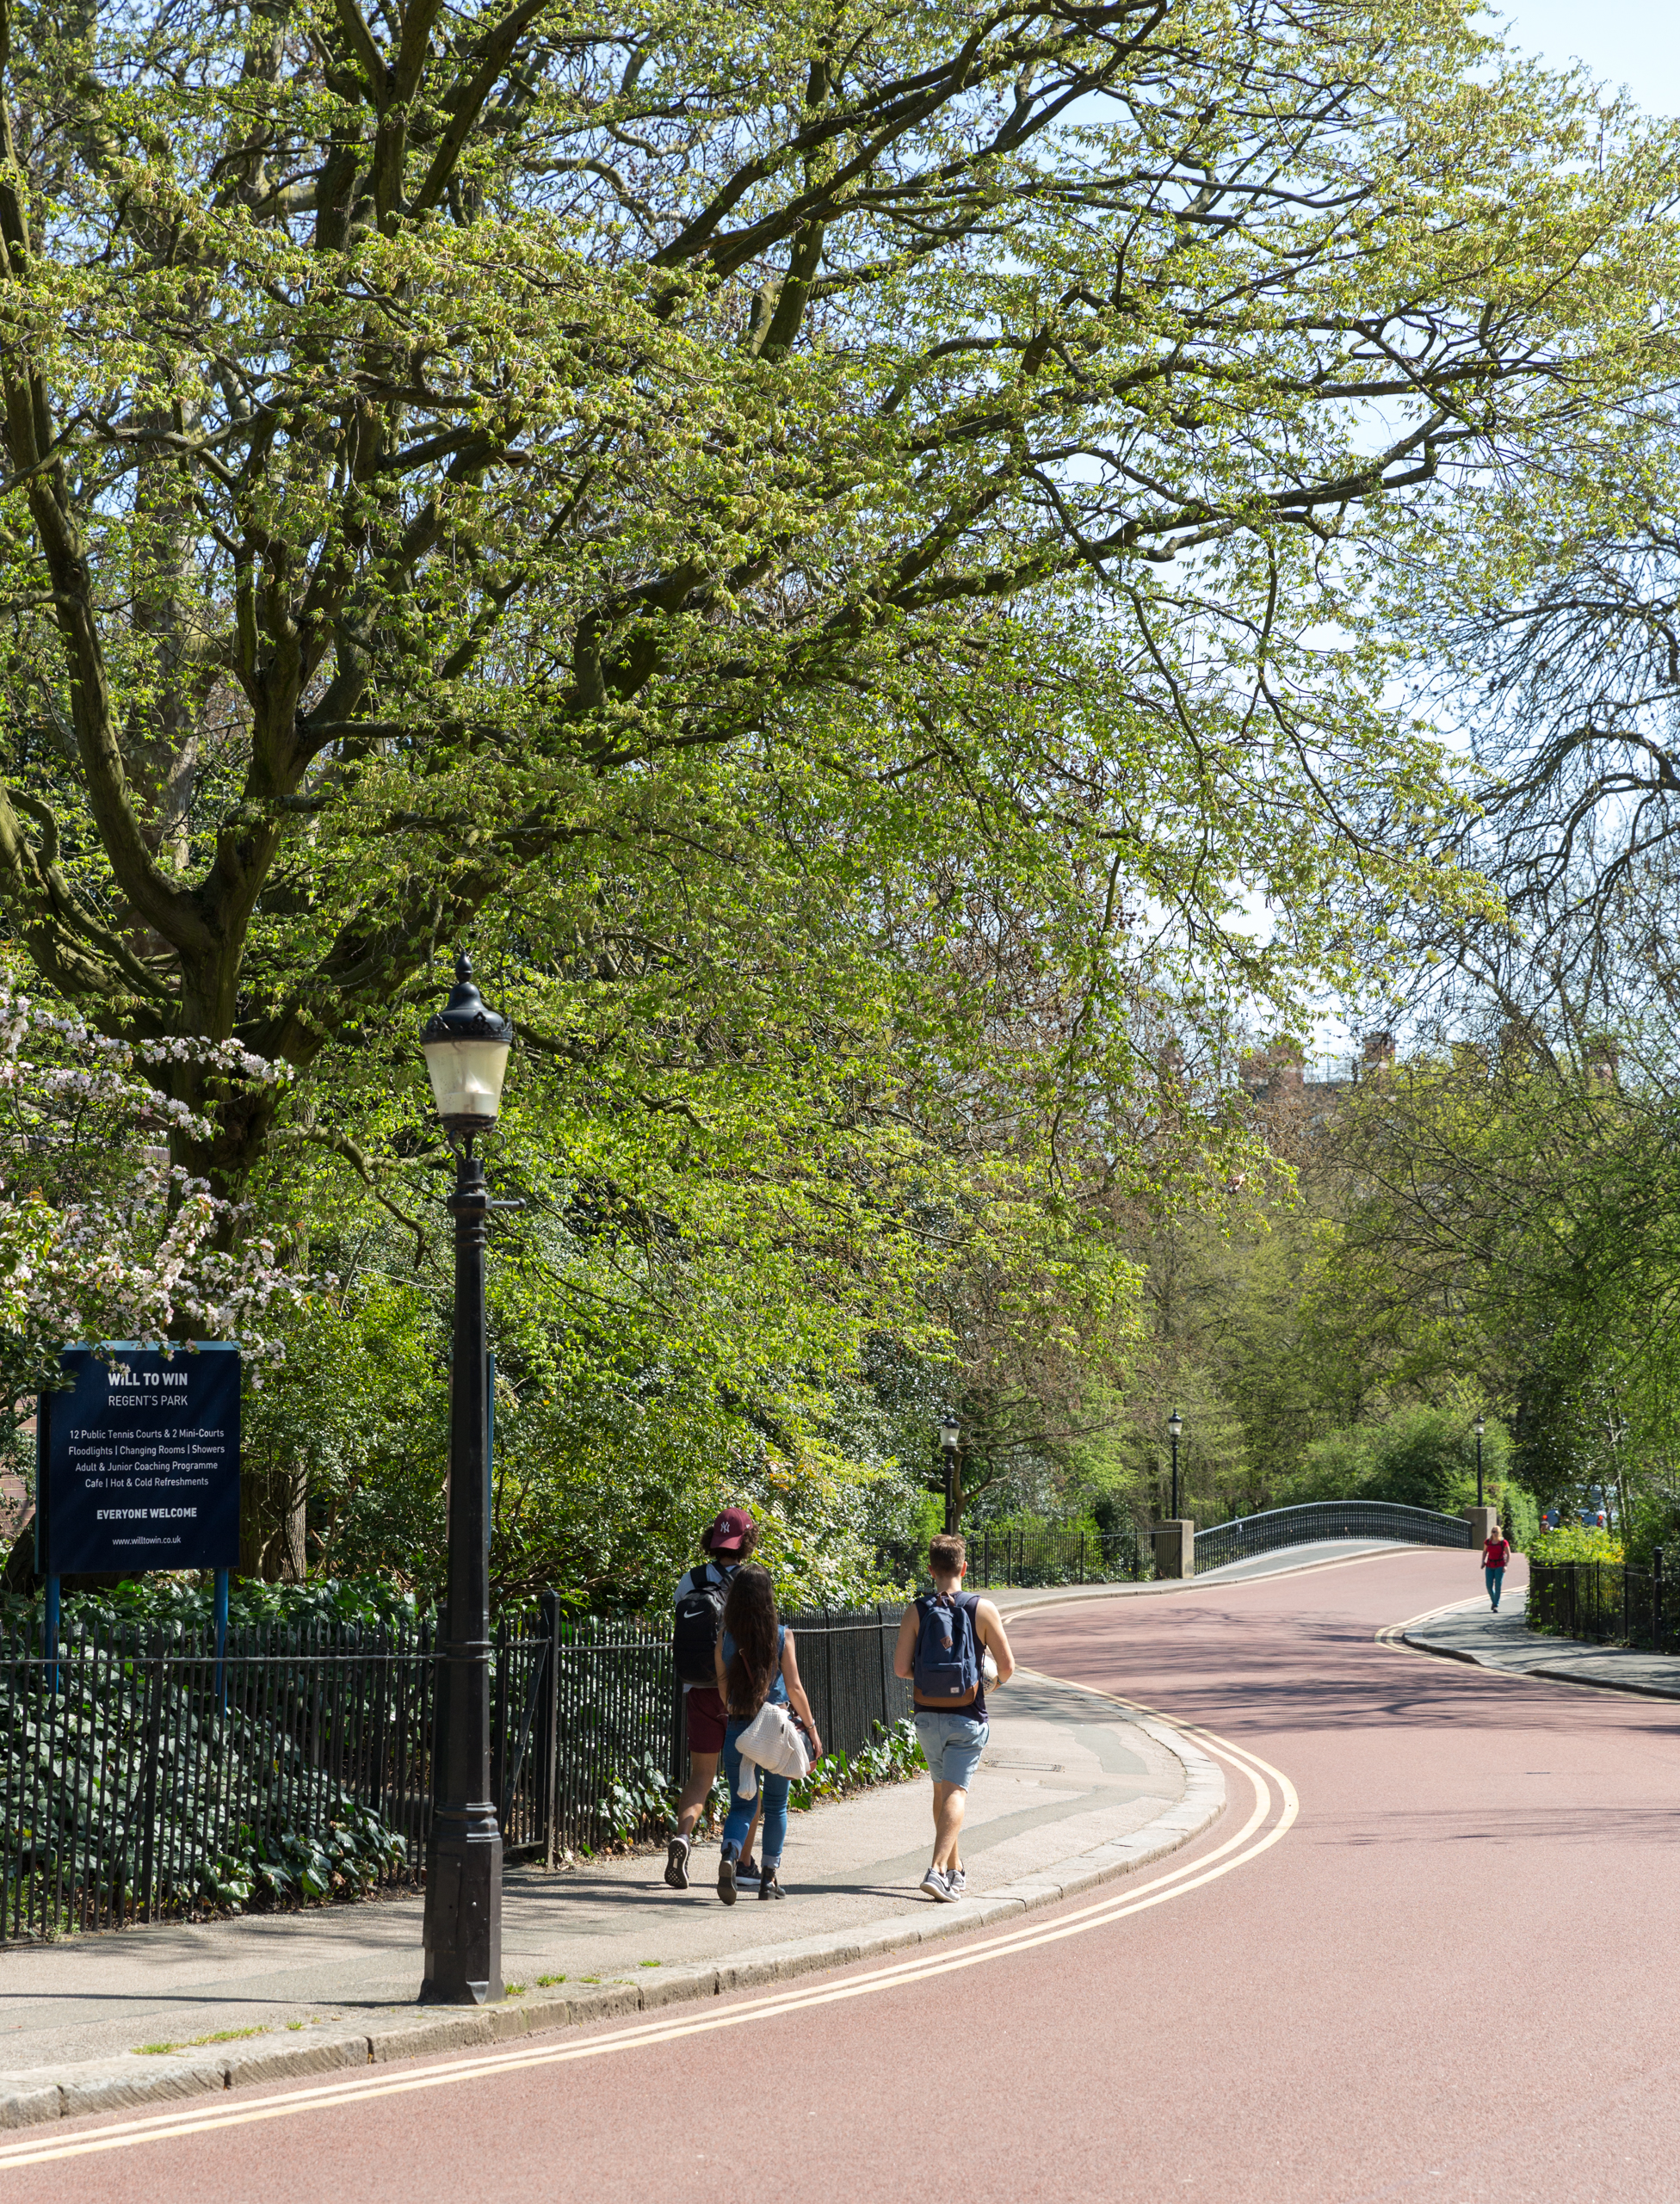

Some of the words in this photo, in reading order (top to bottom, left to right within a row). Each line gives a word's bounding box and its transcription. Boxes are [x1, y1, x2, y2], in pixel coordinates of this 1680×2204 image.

[143, 1373, 160, 1386] TO
[162, 1373, 188, 1386] WIN
[108, 1395, 158, 1406] REGENT'S
[161, 1395, 188, 1405] PARK
[70, 1430, 79, 1439] 12
[81, 1429, 106, 1439] Public
[108, 1429, 134, 1439] Tennis
[136, 1429, 162, 1438] Courts
[164, 1429, 170, 1438] &
[172, 1429, 177, 1438] 2
[179, 1429, 225, 1438] Mini-Courts
[68, 1446, 114, 1457] Floodlights
[120, 1446, 157, 1457] Changing
[158, 1445, 186, 1454] Rooms
[191, 1444, 225, 1454] Showers
[75, 1462, 97, 1472] Adult
[98, 1462, 105, 1472] &
[107, 1462, 133, 1472] Junior
[134, 1461, 170, 1472] Coaching
[172, 1460, 219, 1472] Programme
[85, 1479, 104, 1488] Cafe
[110, 1479, 125, 1487] Hot
[126, 1478, 133, 1487] &
[134, 1478, 153, 1487] Cold
[154, 1477, 209, 1486] Refreshments
[96, 1509, 148, 1520] EVERYONE
[149, 1507, 197, 1518] WELCOME
[112, 1535, 182, 1546] www.willtowin.co.uk
